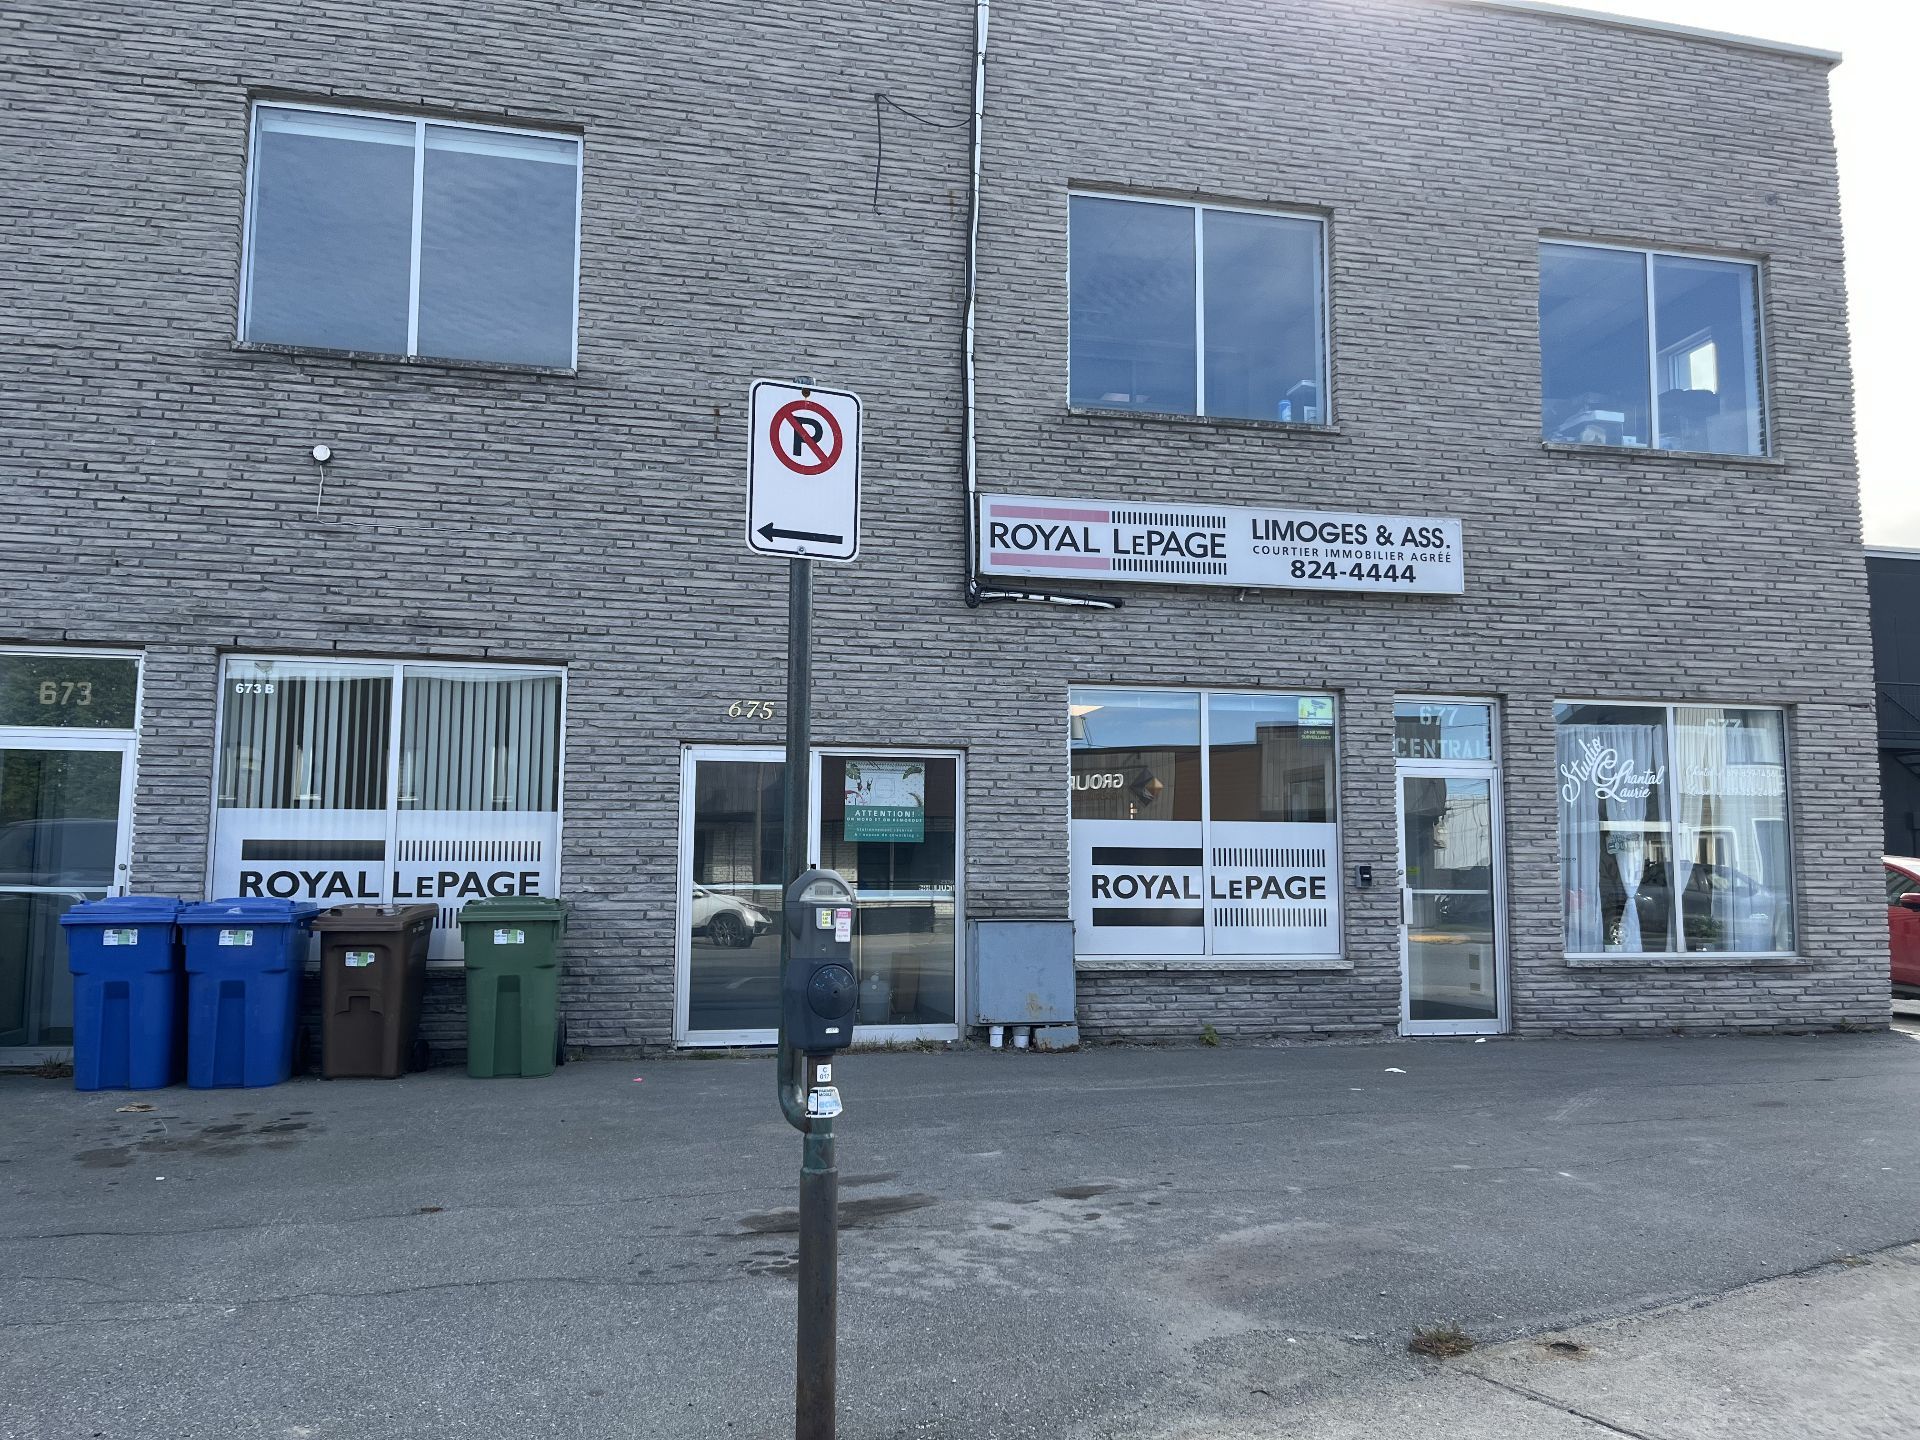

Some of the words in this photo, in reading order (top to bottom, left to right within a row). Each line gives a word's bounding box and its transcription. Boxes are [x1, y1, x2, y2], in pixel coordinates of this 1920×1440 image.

[990, 521, 1101, 553] ROYAL
[1252, 518, 1367, 546] LIMOGES
[1375, 523, 1395, 547] &
[1401, 525, 1451, 549] ASS.
[1252, 545, 1321, 558] COURTIER
[1325, 549, 1405, 562] IMMOBILIER
[1410, 550, 1452, 563] AGRÉÉ
[1290, 560, 1416, 583] 824-4444
[39, 681, 92, 705] 673
[235, 683, 261, 694] 673
[264, 684, 275, 694] B
[728, 700, 775, 720] 675
[1420, 705, 1459, 726] 677
[1561, 736, 1603, 806] Studio
[1591, 748, 1665, 787] Chantal
[1595, 770, 1651, 803] Laurie
[239, 870, 379, 898] ROYAL
[1092, 874, 1201, 899] ROYAL
